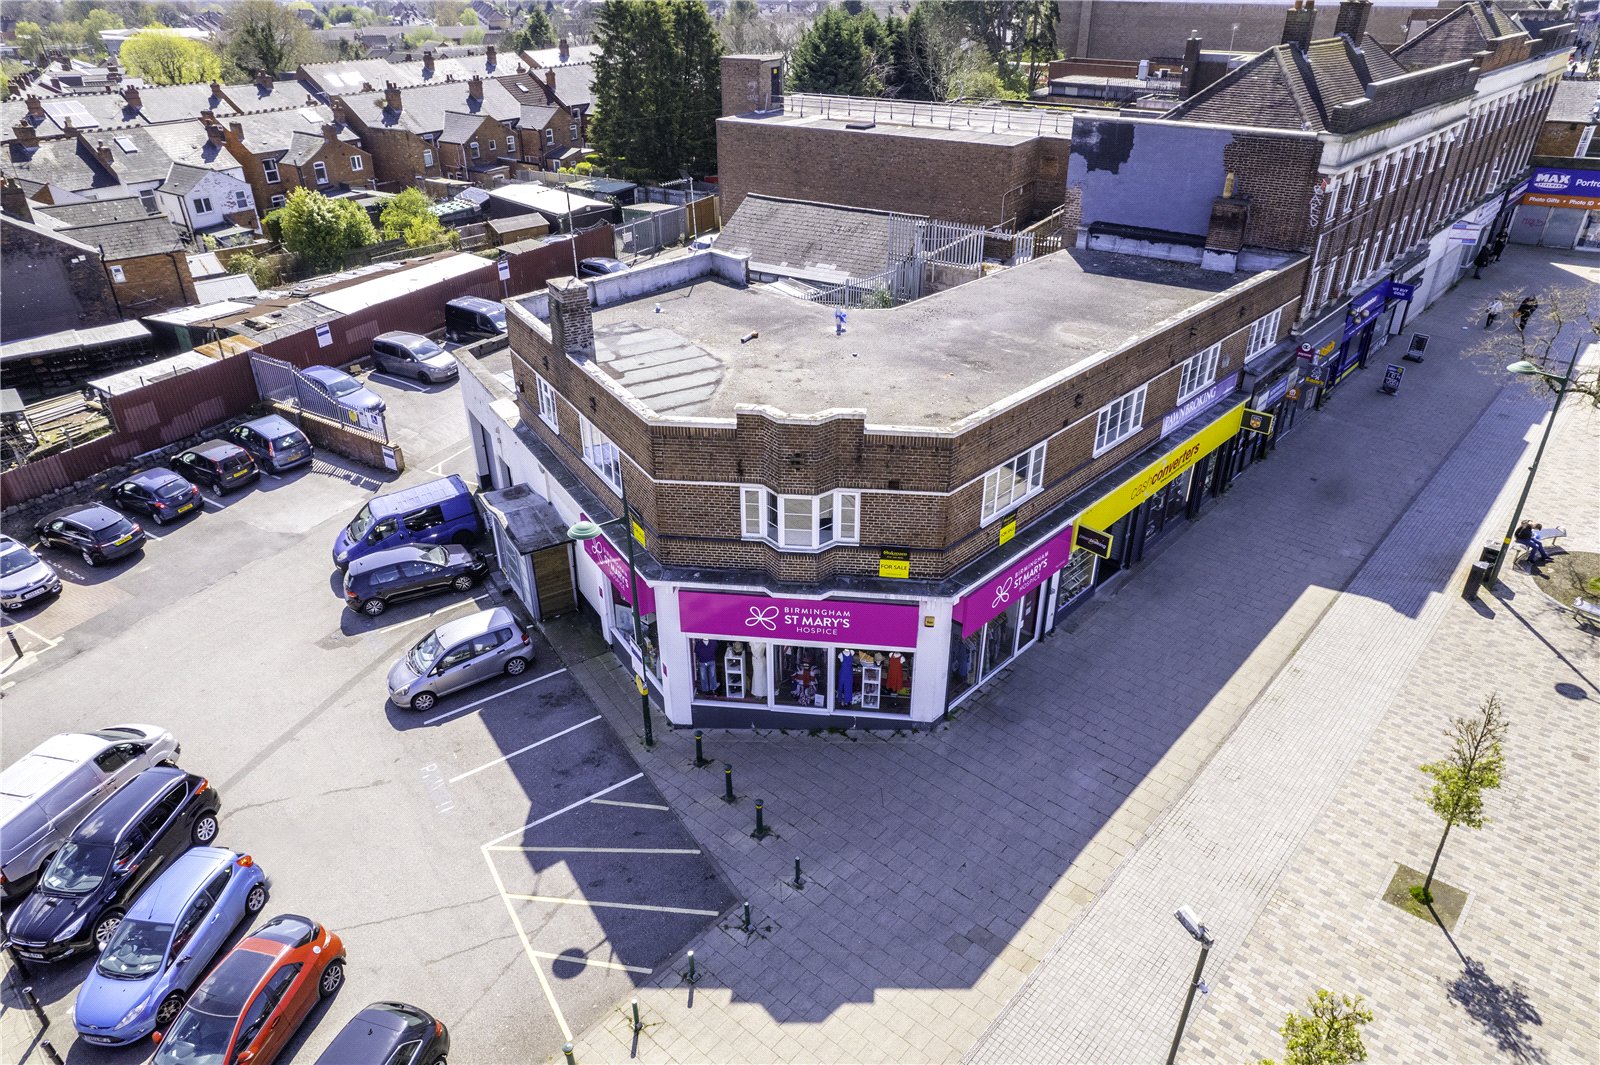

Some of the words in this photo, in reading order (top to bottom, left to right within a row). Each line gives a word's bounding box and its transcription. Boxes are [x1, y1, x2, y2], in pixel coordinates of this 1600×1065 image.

[1536, 174, 1571, 183] MAX
[1165, 386, 1217, 427] PAWNBROKING
[1015, 551, 1049, 577] BIRMINGHAM
[1014, 577, 1022, 589] ST
[1022, 558, 1048, 583] MARY'S
[1019, 573, 1040, 592] HOSPICE
[784, 607, 851, 617] BIRMINGHAM
[784, 615, 799, 625] ST
[802, 616, 850, 628] MARY'S
[796, 627, 838, 636] HOSPICE
